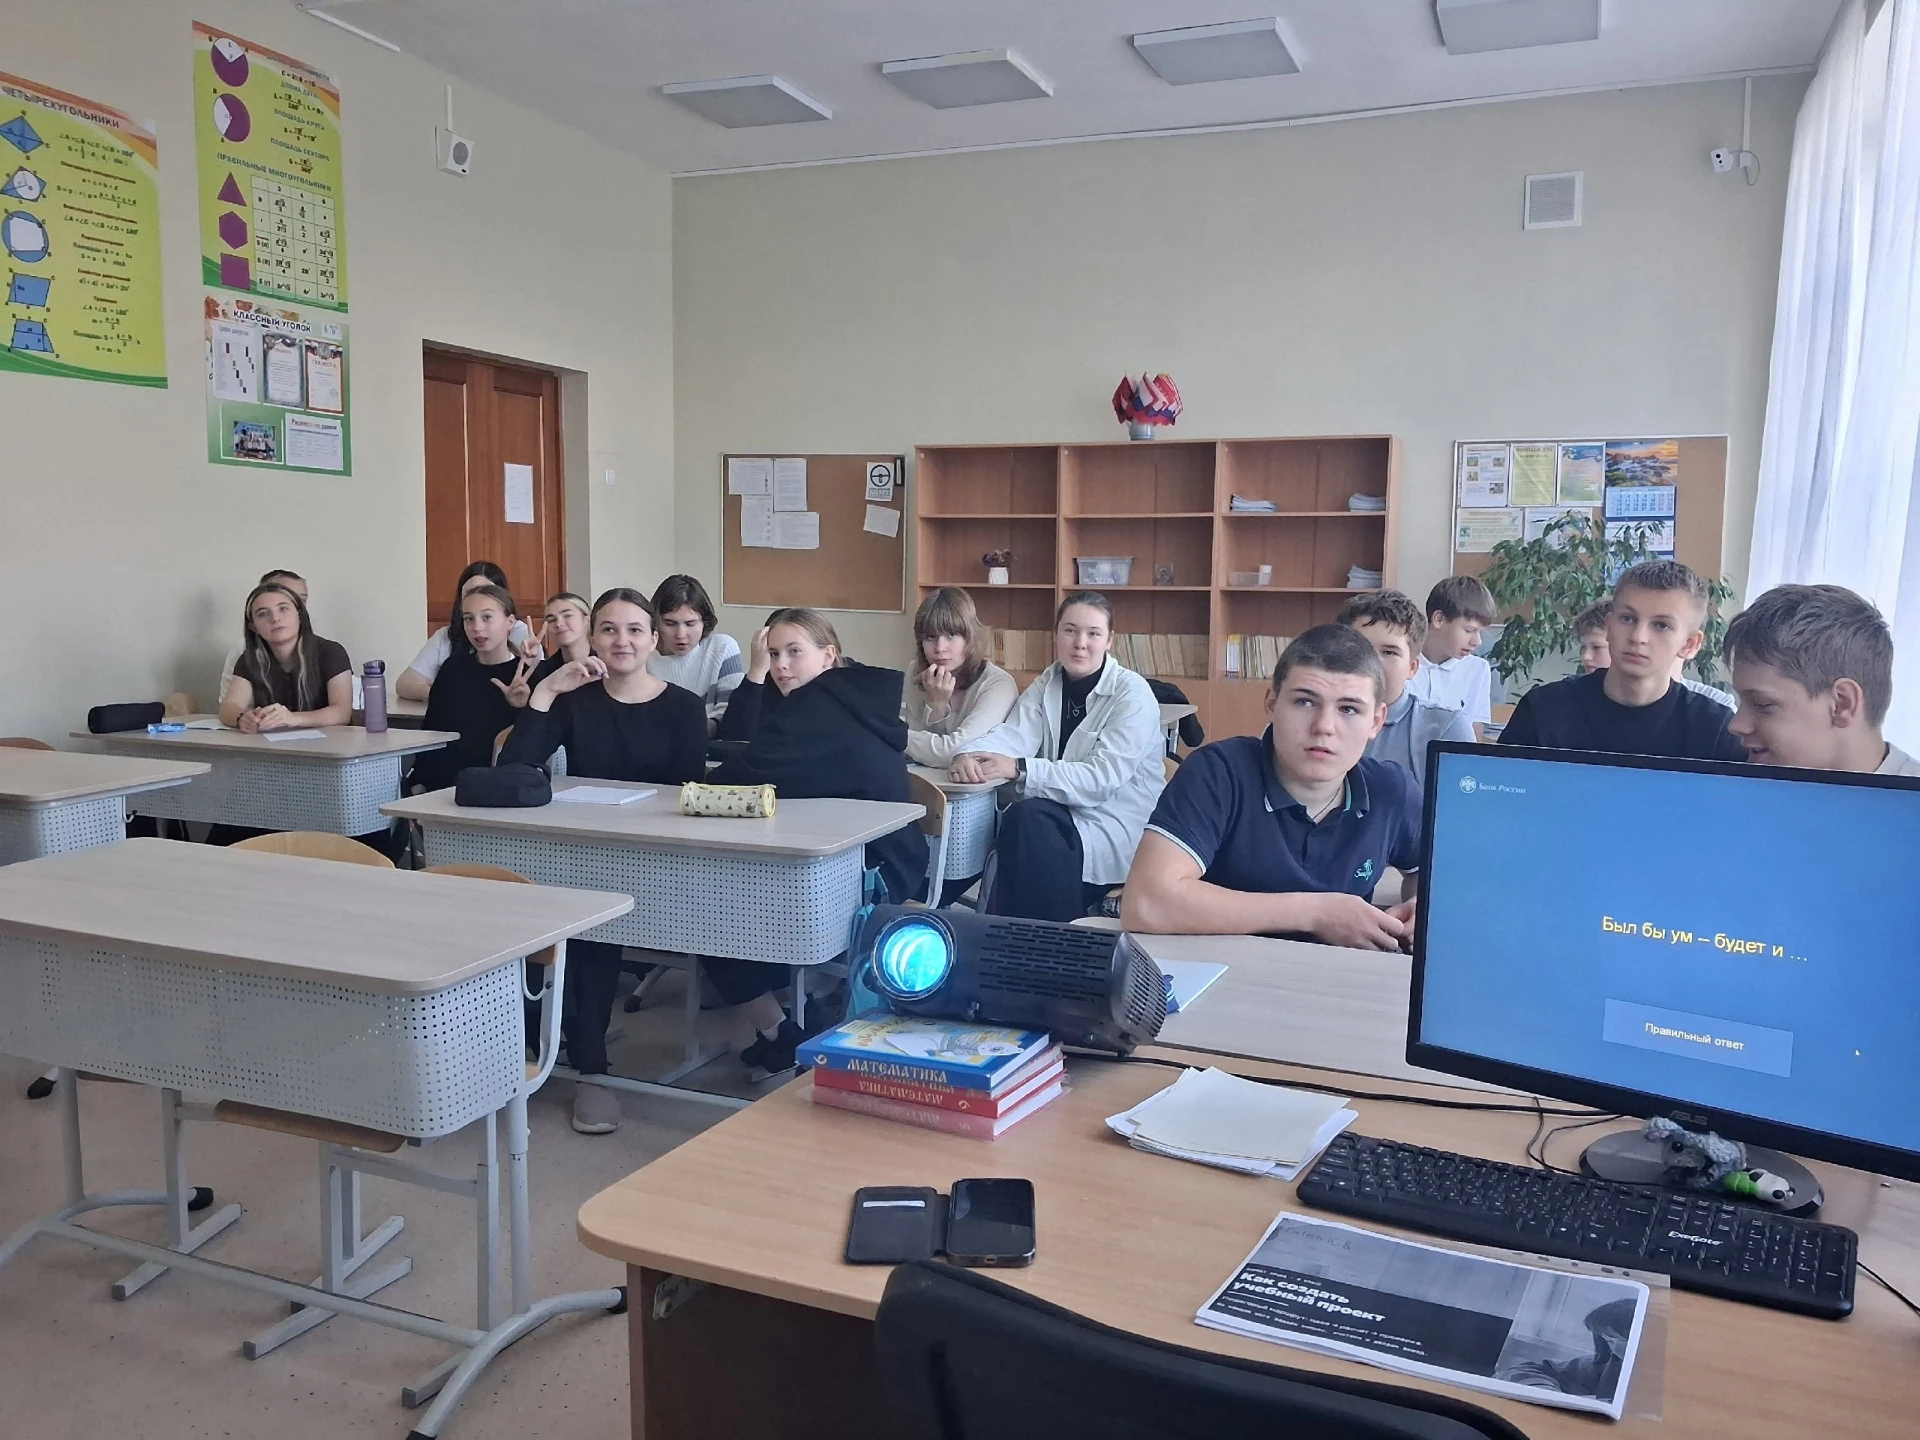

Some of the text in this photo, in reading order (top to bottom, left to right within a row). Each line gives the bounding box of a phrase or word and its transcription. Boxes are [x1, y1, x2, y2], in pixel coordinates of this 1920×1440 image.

[217, 152, 267, 173] ПРАВИЛЬНЫЕ
[268, 168, 332, 192] МНОГОУГОЛЬНИКИ
[233, 310, 312, 333] КЛАССНЫЙ УГОЛОК
[1498, 784, 1526, 794] России
[1602, 916, 1637, 935] Был
[1642, 922, 1666, 940] бы
[1671, 930, 1693, 944] ум
[1714, 933, 1767, 954] будет
[1772, 945, 1784, 958] и
[1645, 1022, 1745, 1051] Правильный ответ
[847, 1058, 948, 1084] МАТЕМАТИКА
[858, 1080, 943, 1105] МАТЕМАТИКА
[1669, 1109, 1708, 1126] ASUS
[1667, 1230, 1723, 1246] ExeGate
[1239, 1272, 1276, 1286] Как
[1277, 1281, 1350, 1304] создать
[1233, 1282, 1386, 1322] учебный проект
